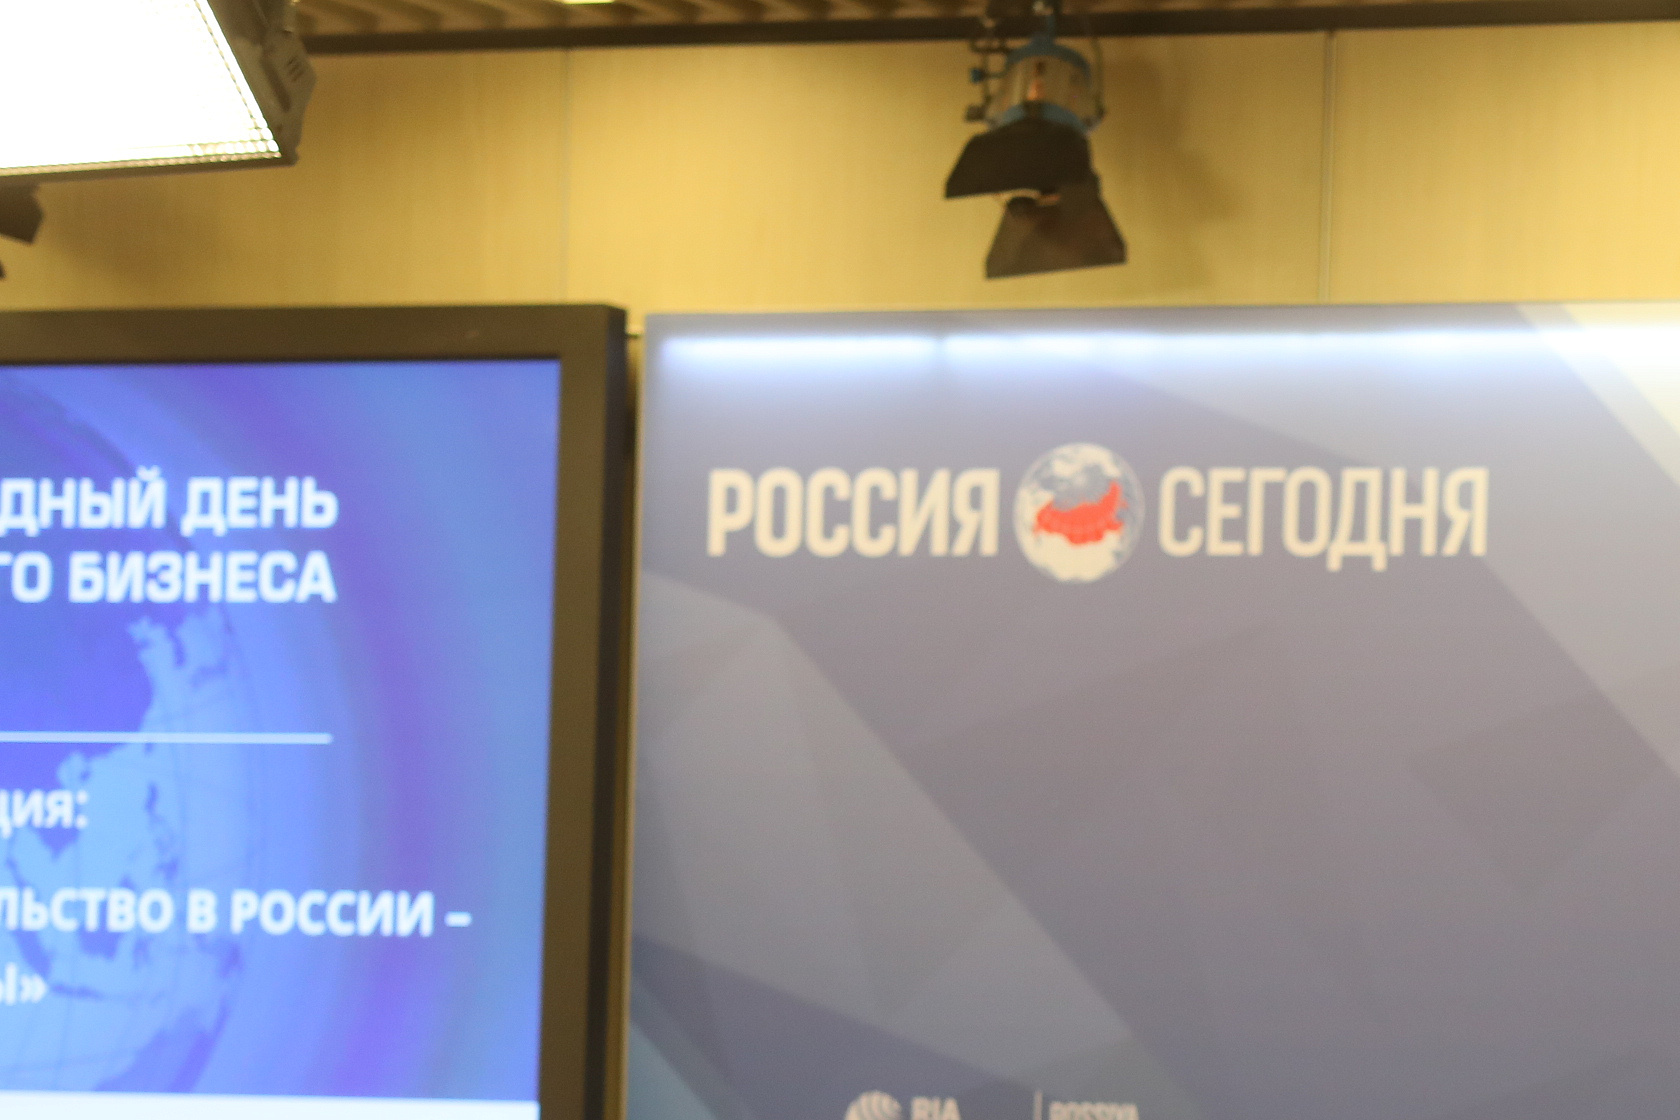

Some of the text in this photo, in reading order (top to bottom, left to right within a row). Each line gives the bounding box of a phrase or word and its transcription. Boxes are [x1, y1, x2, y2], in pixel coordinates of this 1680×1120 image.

[180, 476, 339, 537] ДЕНЬ
[706, 466, 1489, 572] РОССИЯ СЕГОДНЯ
[0, 550, 337, 604] О БИЗНЕСА
[187, 889, 217, 934] В
[230, 889, 435, 937] РОССИИ
